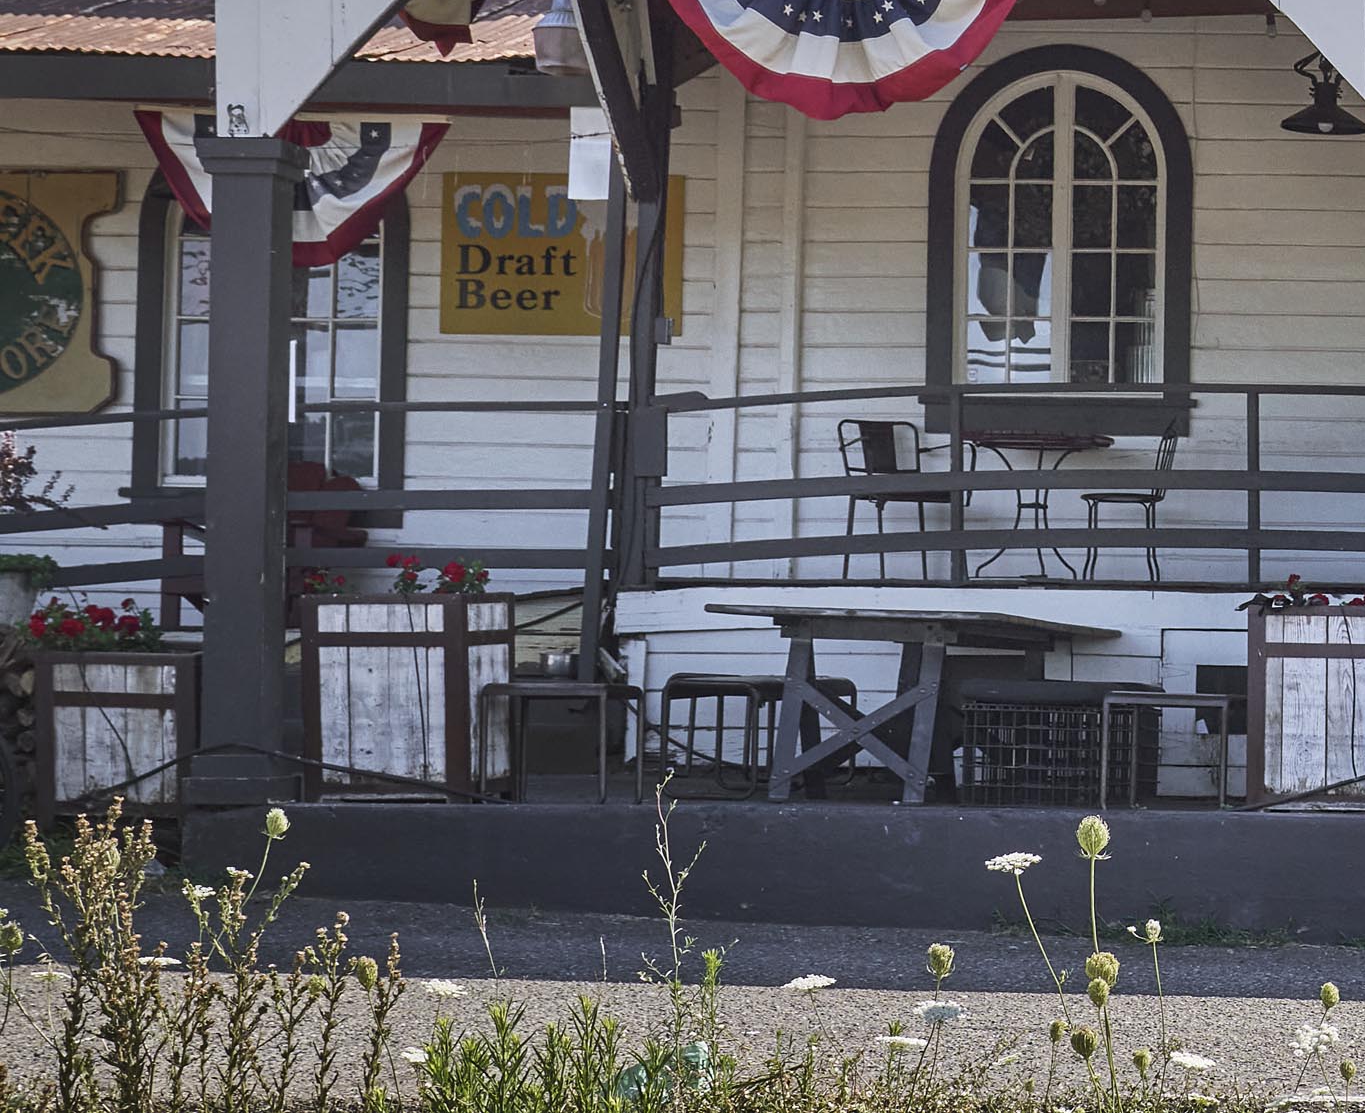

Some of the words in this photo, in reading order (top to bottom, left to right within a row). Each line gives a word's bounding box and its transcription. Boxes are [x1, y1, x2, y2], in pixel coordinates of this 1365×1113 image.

[454, 183, 578, 239] COLD
[456, 243, 577, 276] Draft
[455, 278, 561, 311] Beer
